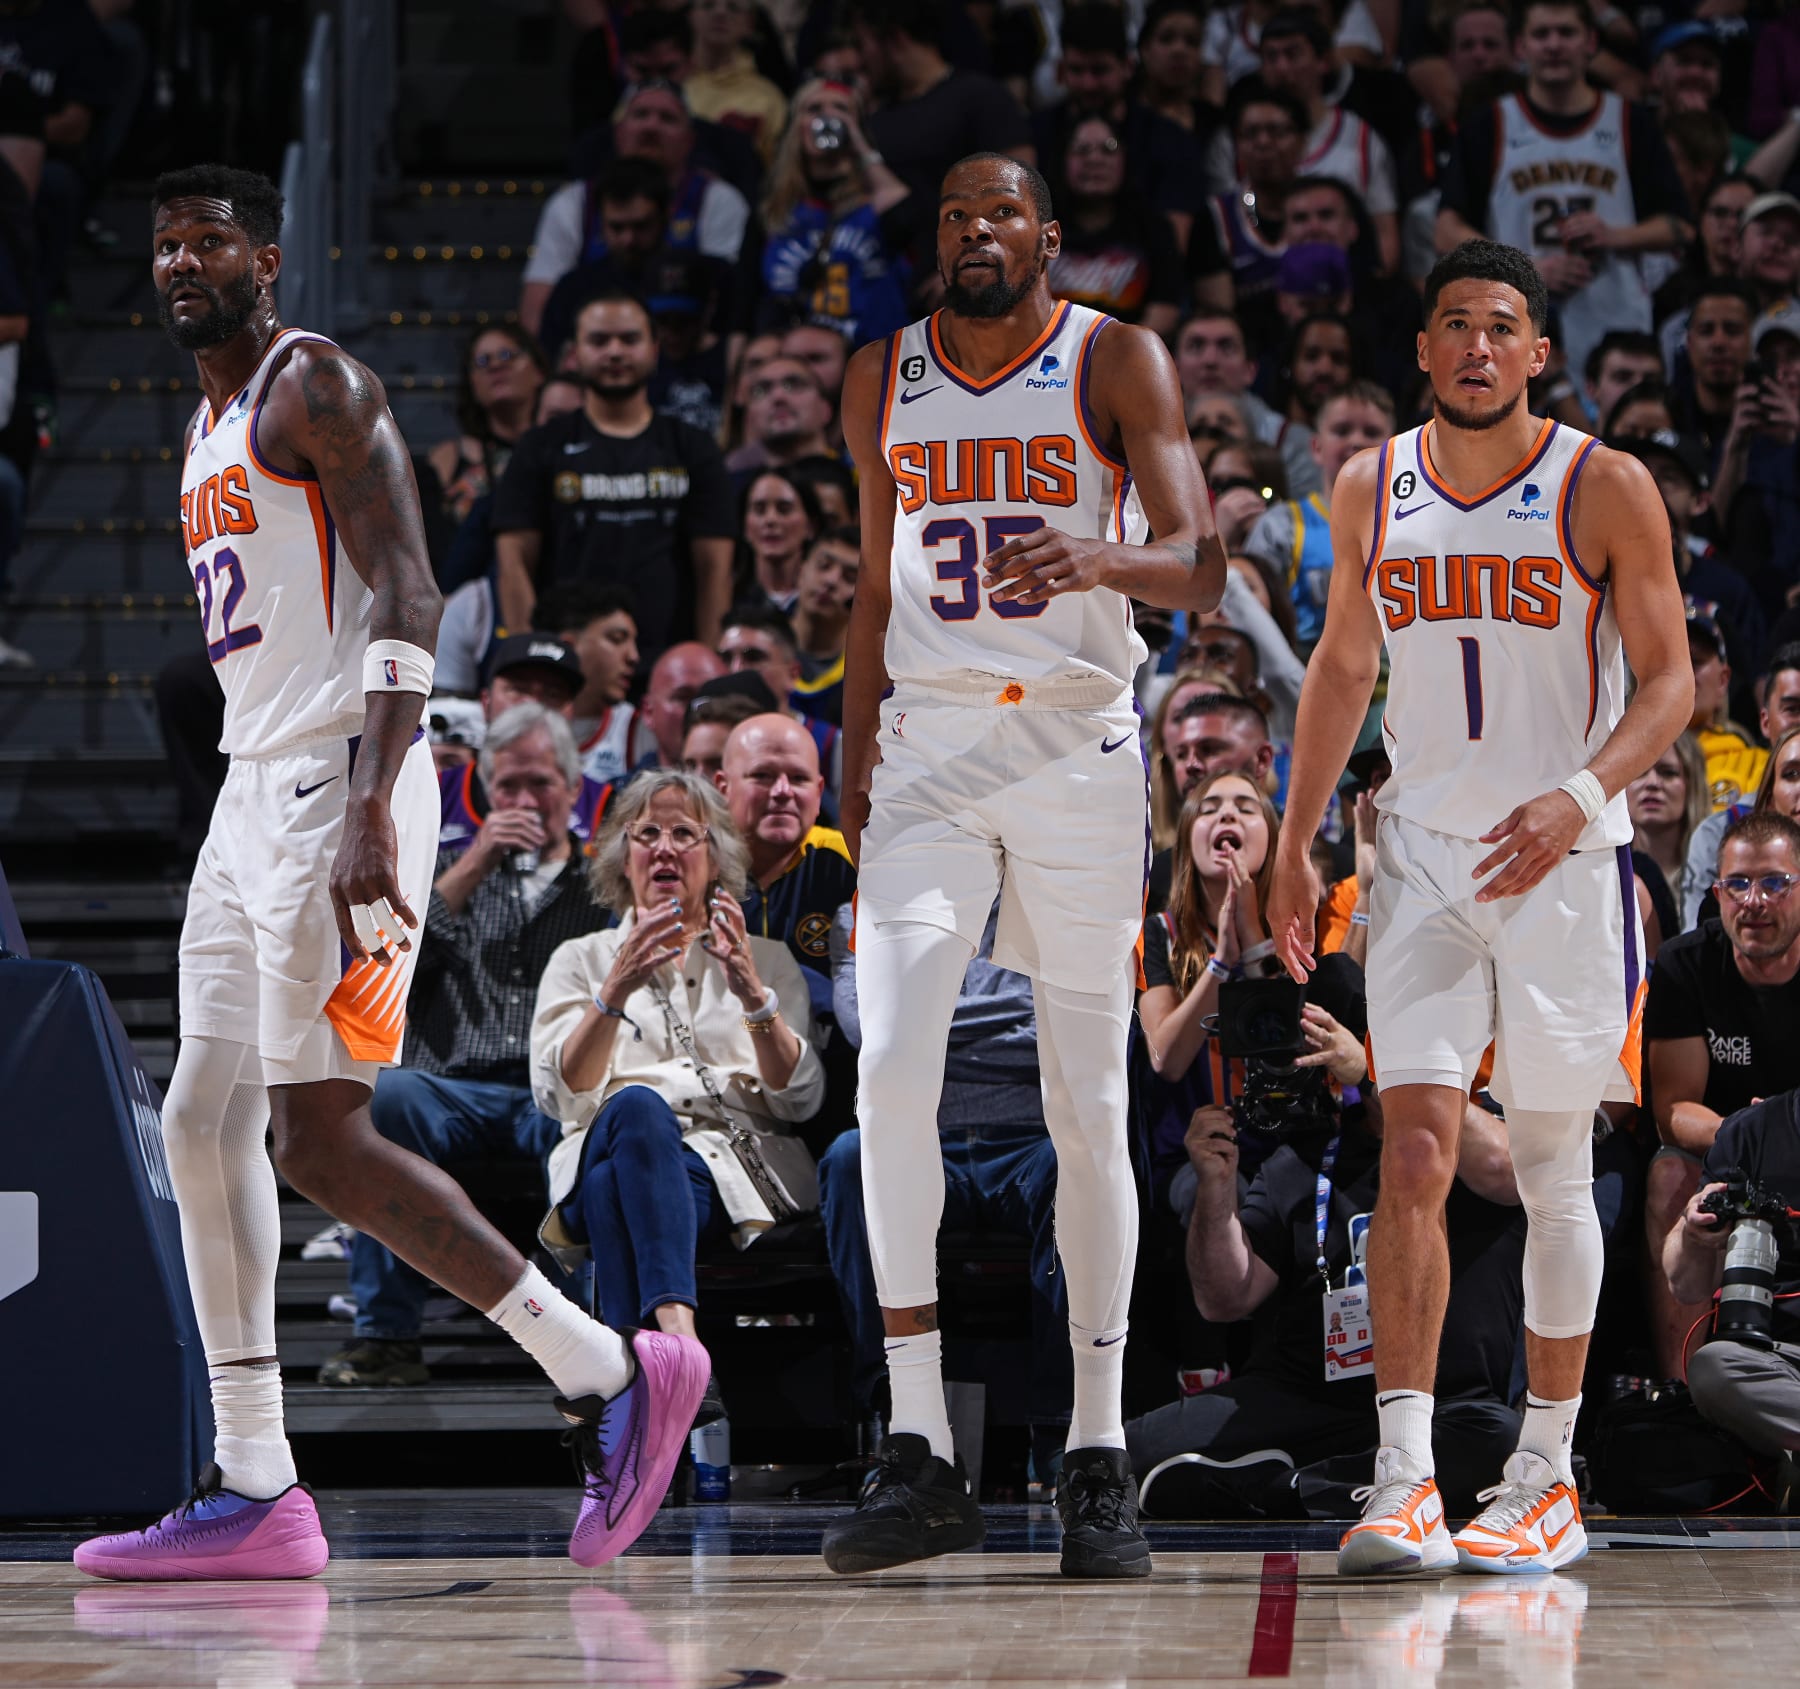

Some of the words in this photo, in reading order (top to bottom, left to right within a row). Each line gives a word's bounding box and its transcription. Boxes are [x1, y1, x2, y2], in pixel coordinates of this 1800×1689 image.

[1510, 160, 1617, 195] DENVER
[1025, 379, 1068, 390] PayPal
[889, 434, 1077, 516] SUNS
[1507, 509, 1550, 522] PayPal
[195, 547, 263, 664] 22
[1378, 554, 1562, 632] SUNS
[1456, 636, 1484, 741] 1
